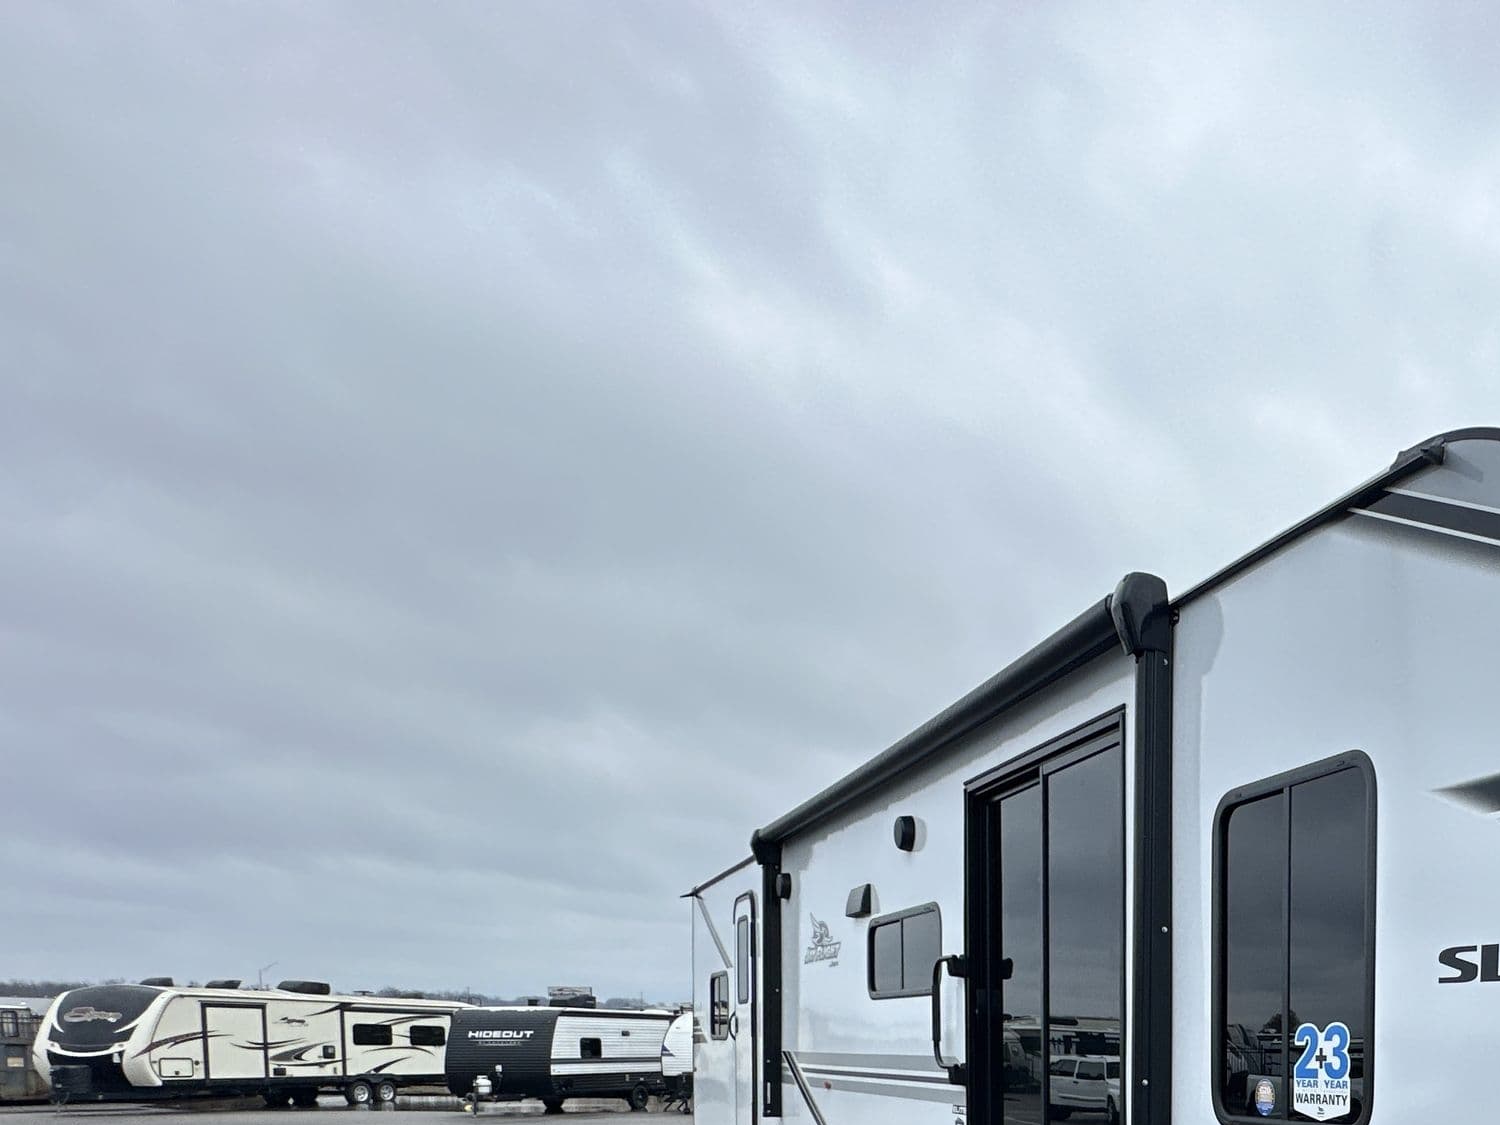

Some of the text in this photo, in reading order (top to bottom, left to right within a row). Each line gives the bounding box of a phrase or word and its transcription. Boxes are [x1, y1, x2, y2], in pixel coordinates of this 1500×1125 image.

[468, 1030, 534, 1039] HIDEOUT
[1296, 1080, 1348, 1089] YEAR YEAR
[1296, 1093, 1348, 1106] WARRANTY
